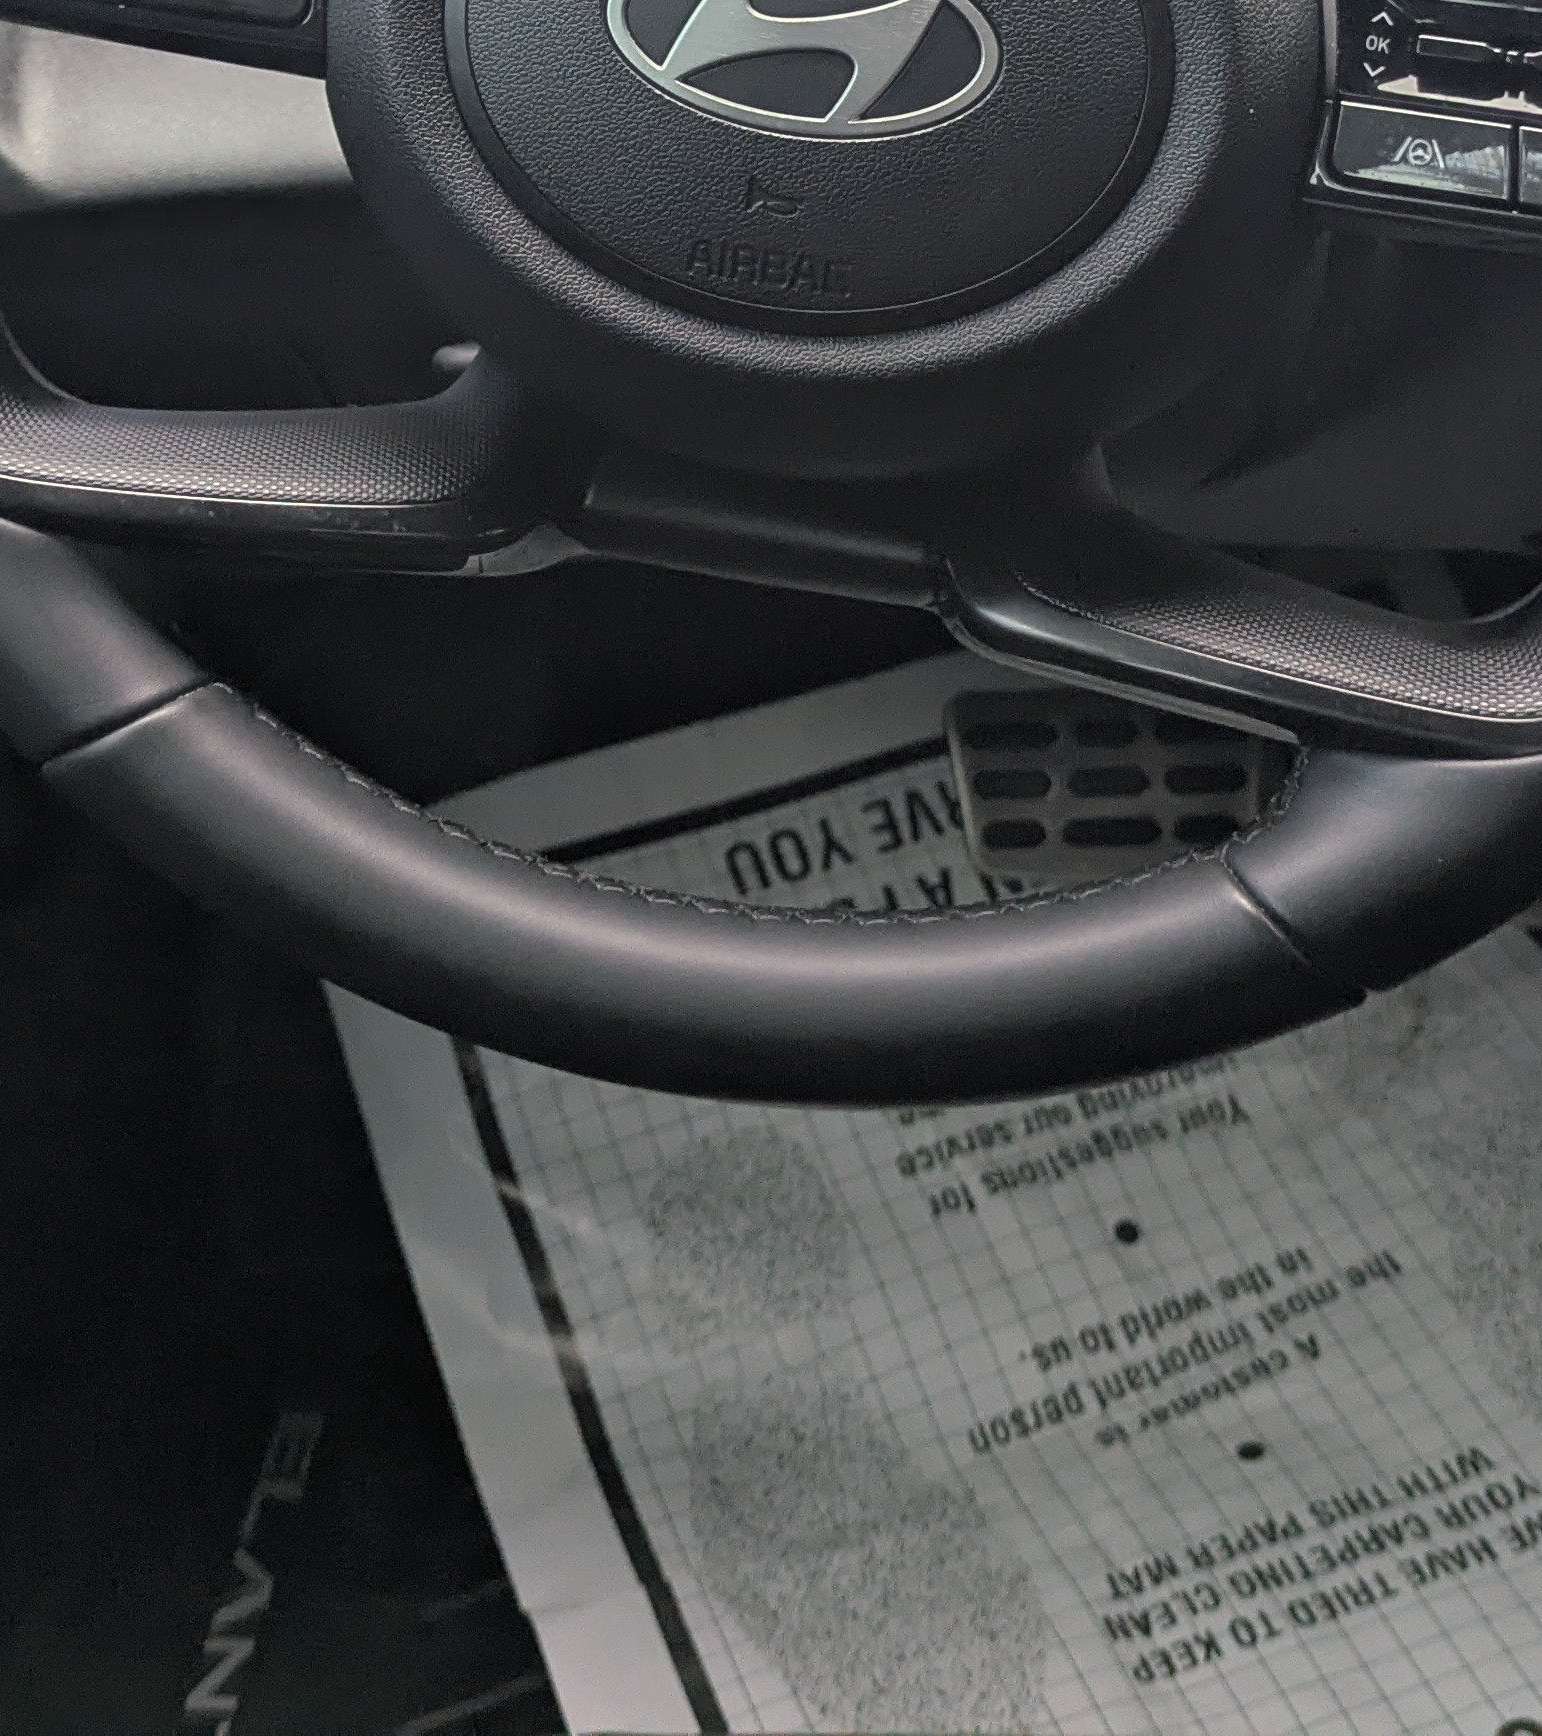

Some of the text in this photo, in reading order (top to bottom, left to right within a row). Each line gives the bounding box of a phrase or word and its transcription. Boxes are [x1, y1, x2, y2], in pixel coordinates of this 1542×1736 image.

[1365, 34, 1390, 54] OK
[723, 780, 967, 895] RVE YOU
[1022, 1102, 1074, 1137] our
[896, 1118, 1014, 1179] service
[929, 1093, 1251, 1218] Your suggestions for
[1217, 1262, 1275, 1302] the
[1275, 1246, 1316, 1273] in
[1078, 1321, 1115, 1357] to
[1119, 1288, 1214, 1348] world
[968, 1249, 1403, 1455] the most important person
[1293, 1332, 1322, 1362] A
[1137, 1350, 1291, 1434] customer
[1105, 1445, 1497, 1602] WITH THIS PAPER MAT
[183, 1409, 325, 1736] ELAN
[1101, 1473, 1542, 1642] YOUR CARPETING CLEAN
[1402, 1535, 1500, 1589] HAVE
[1286, 1571, 1398, 1628] TRIED
[1131, 1631, 1223, 1684] KEEP
[1228, 1610, 1282, 1649] TO
